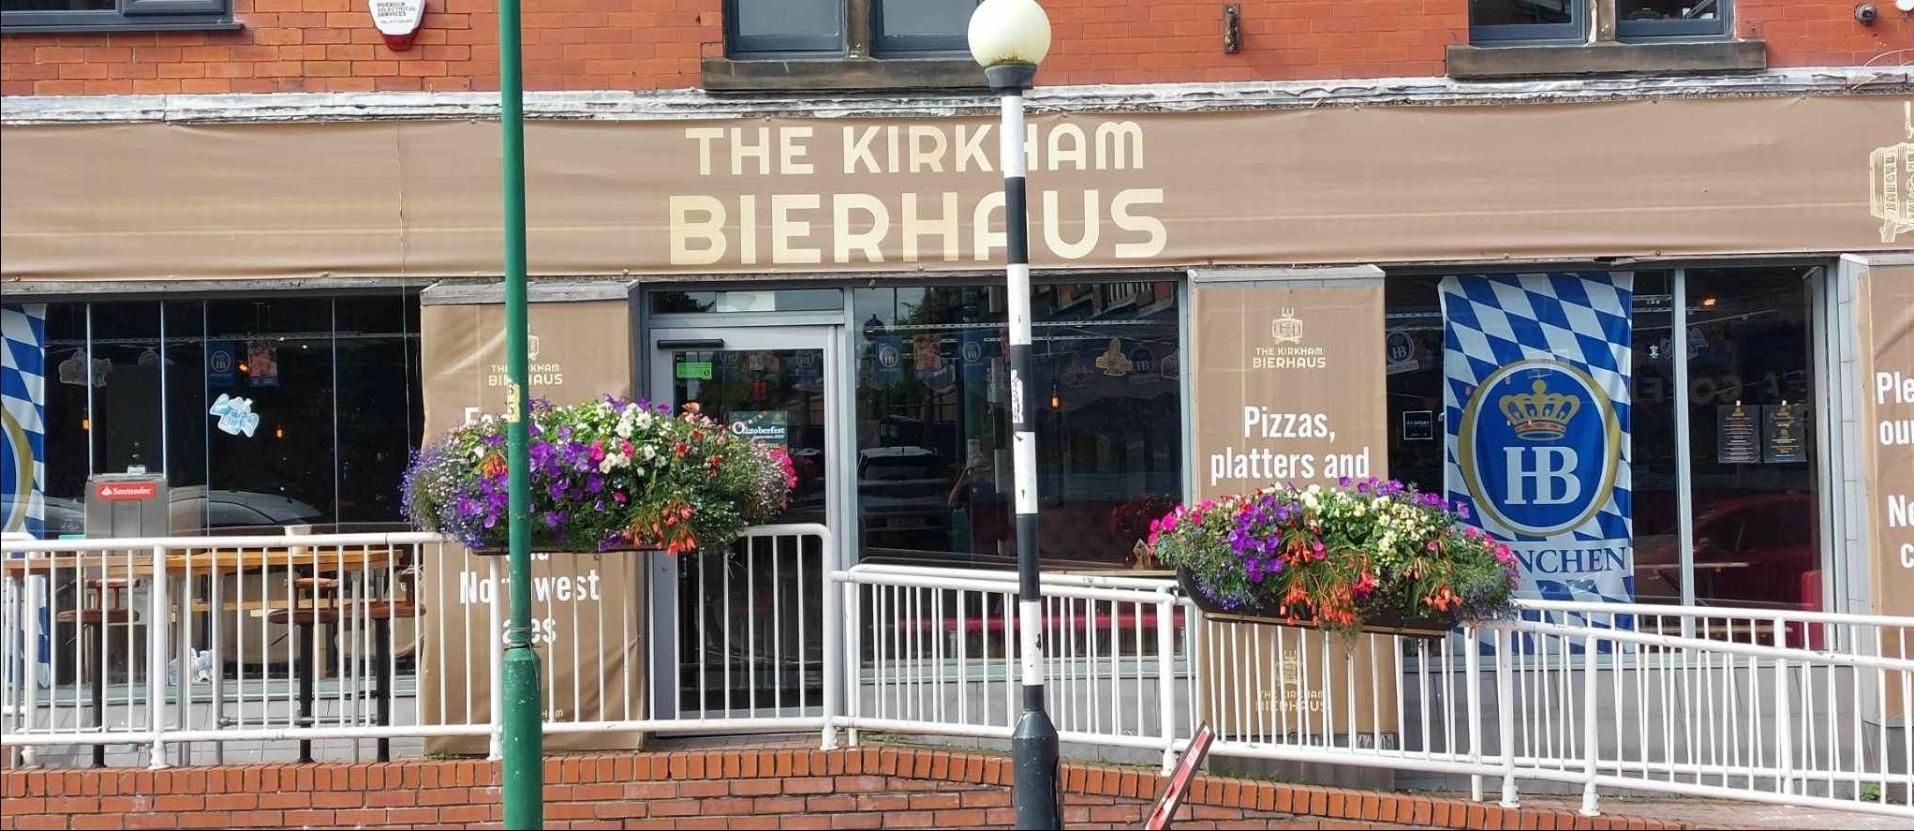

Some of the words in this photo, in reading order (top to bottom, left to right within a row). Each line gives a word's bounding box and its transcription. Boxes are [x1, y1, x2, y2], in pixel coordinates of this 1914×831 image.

[685, 126, 814, 176] THE
[842, 121, 1144, 174] KIRKHAM
[669, 188, 1168, 265] BIERHAUS
[1252, 357, 1326, 368] BIERHAUS
[1255, 347, 1274, 356] THE
[1277, 347, 1323, 355] KIRKHAM
[529, 363, 560, 373] KHAM
[1244, 406, 1336, 442] Pizzas,
[1210, 446, 1315, 487] platters
[1324, 446, 1370, 480] and
[1503, 446, 1582, 505] HB
[112, 486, 152, 496] Santander
[1517, 546, 1627, 574] NCHEN
[502, 617, 557, 645] aes
